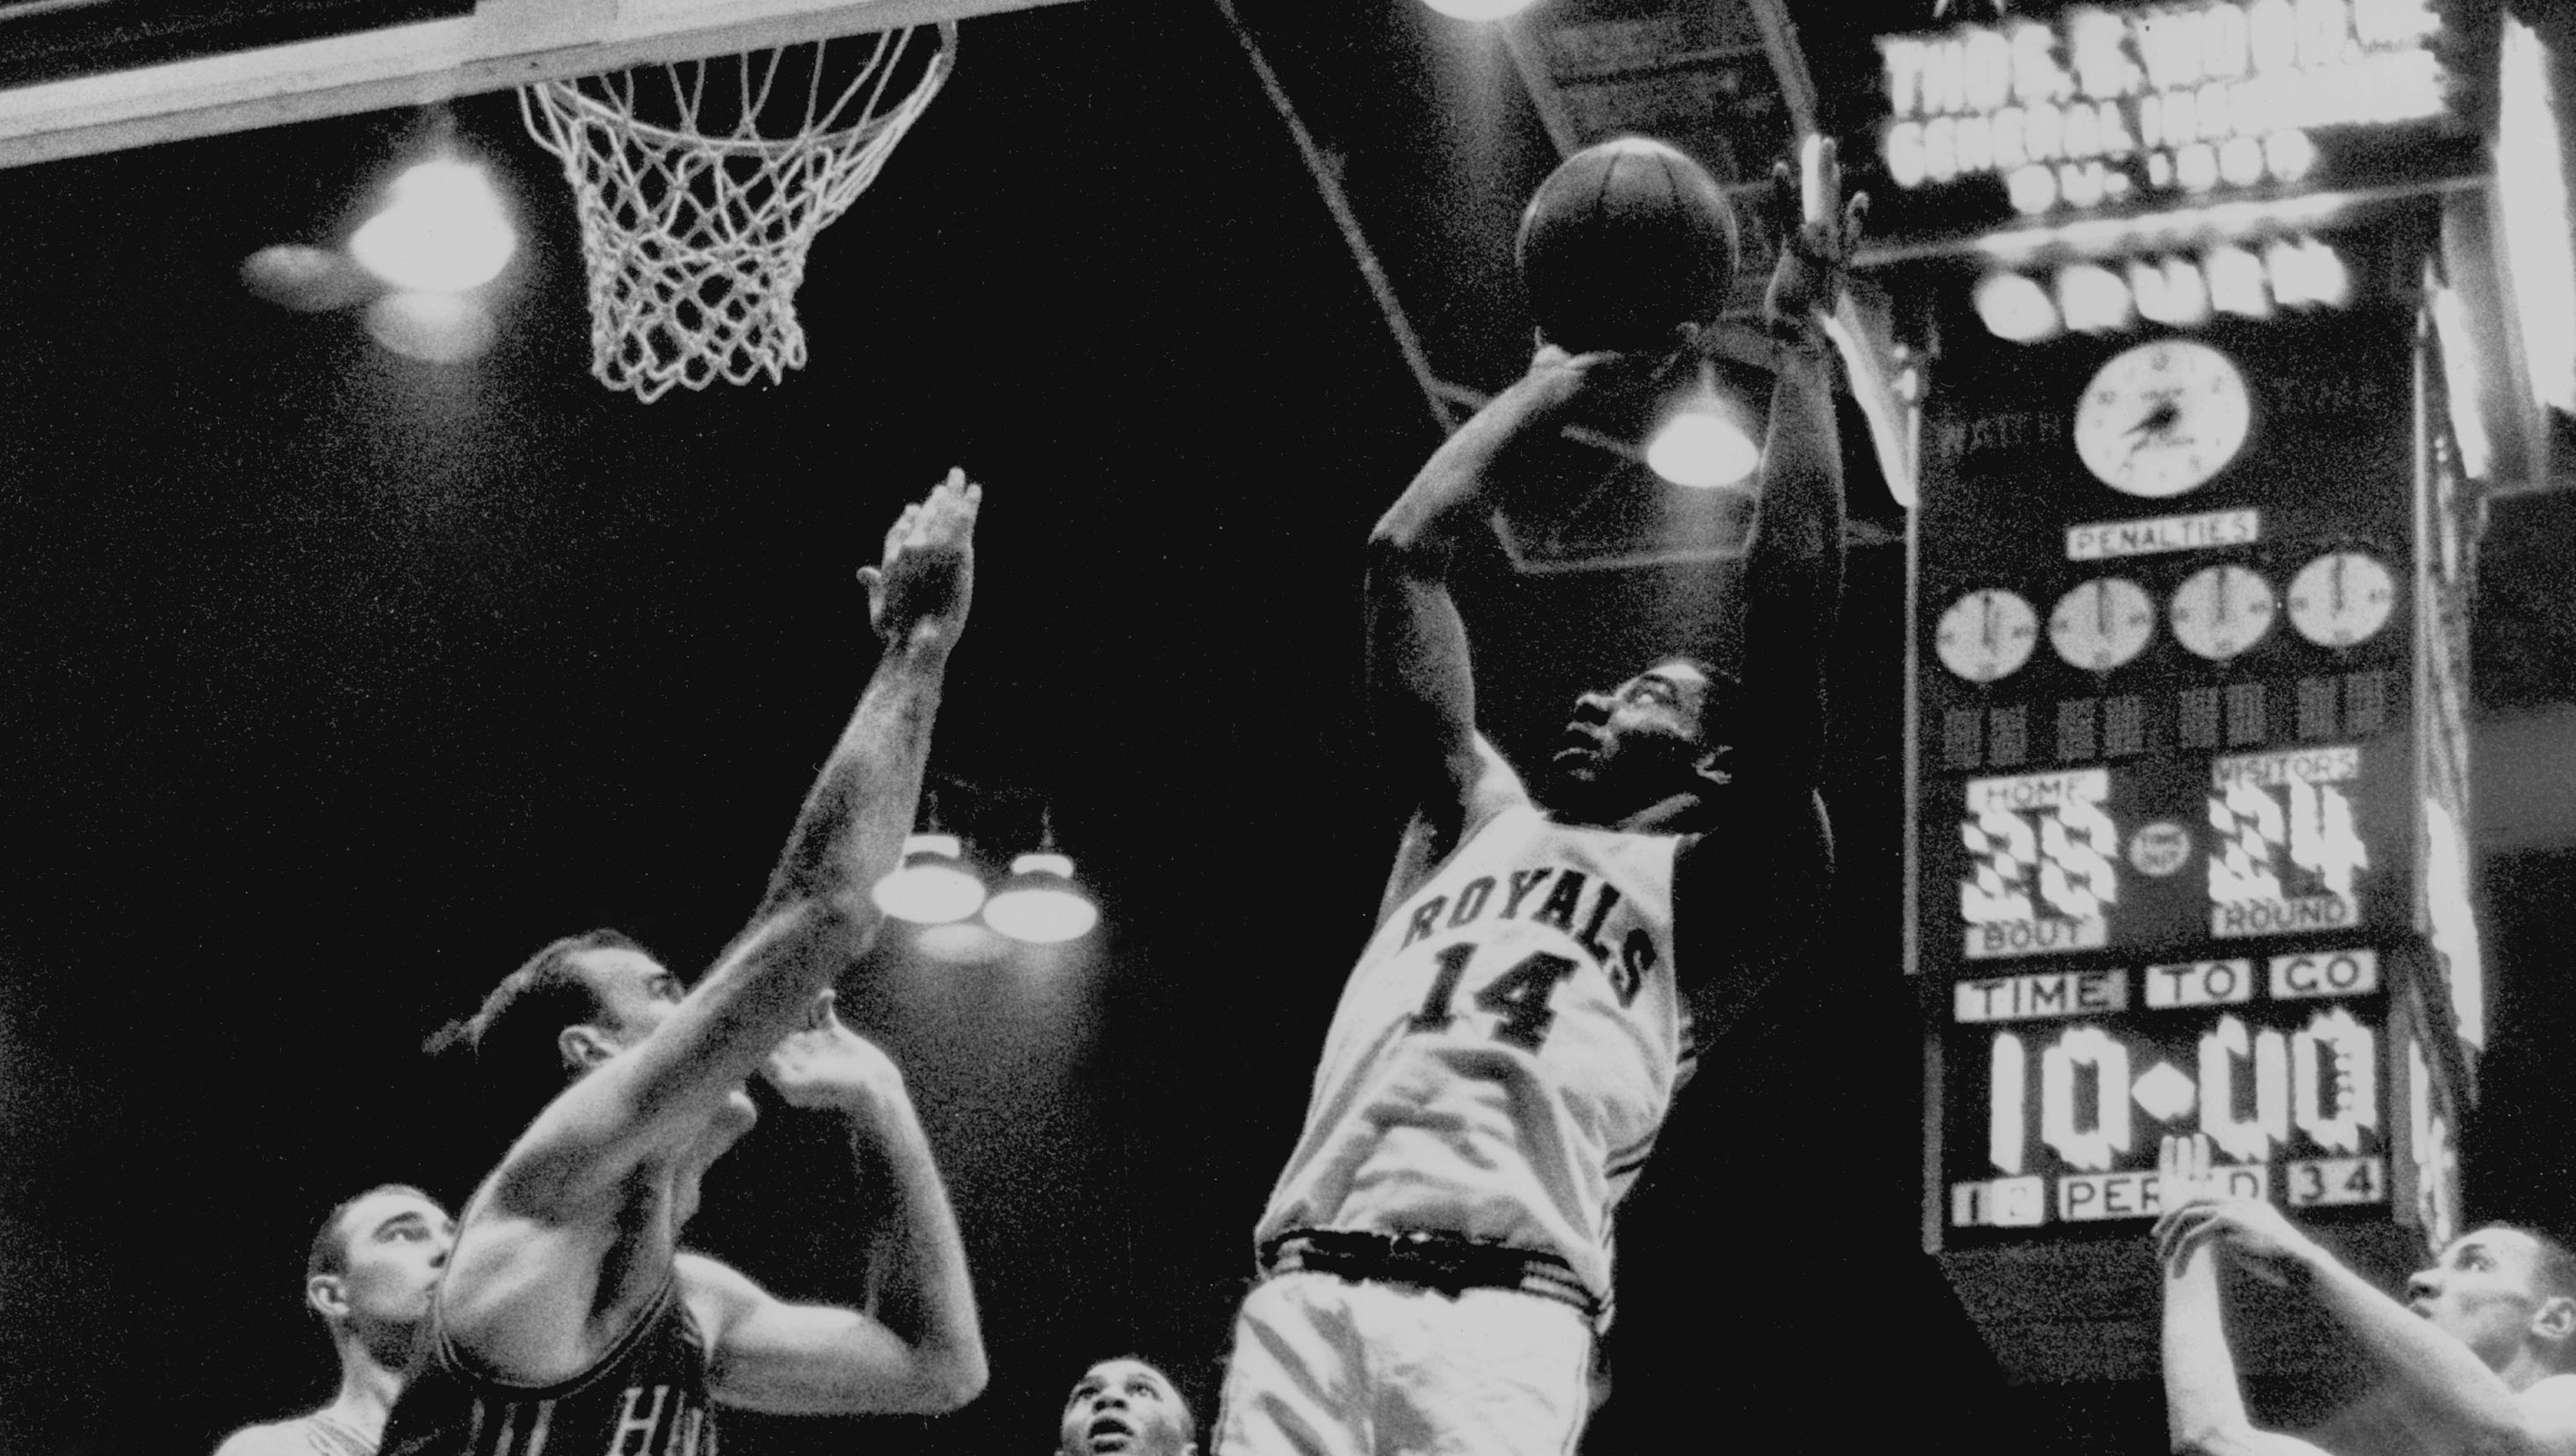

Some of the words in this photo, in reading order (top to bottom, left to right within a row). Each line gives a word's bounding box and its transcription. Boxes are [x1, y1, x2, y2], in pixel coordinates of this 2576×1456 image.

[2076, 512, 2249, 559] PENALTIES
[2216, 750, 2357, 785] VISITORS
[1986, 773, 2088, 814] HOME
[1982, 918, 2081, 953] BOUT
[2224, 897, 2348, 932] ROUND
[1398, 867, 1658, 1010] ROYALS
[1406, 941, 1581, 1053] 14
[1972, 974, 2106, 1017] TIME
[2157, 961, 2238, 1003] TO
[2066, 1170, 2260, 1216] PERD
